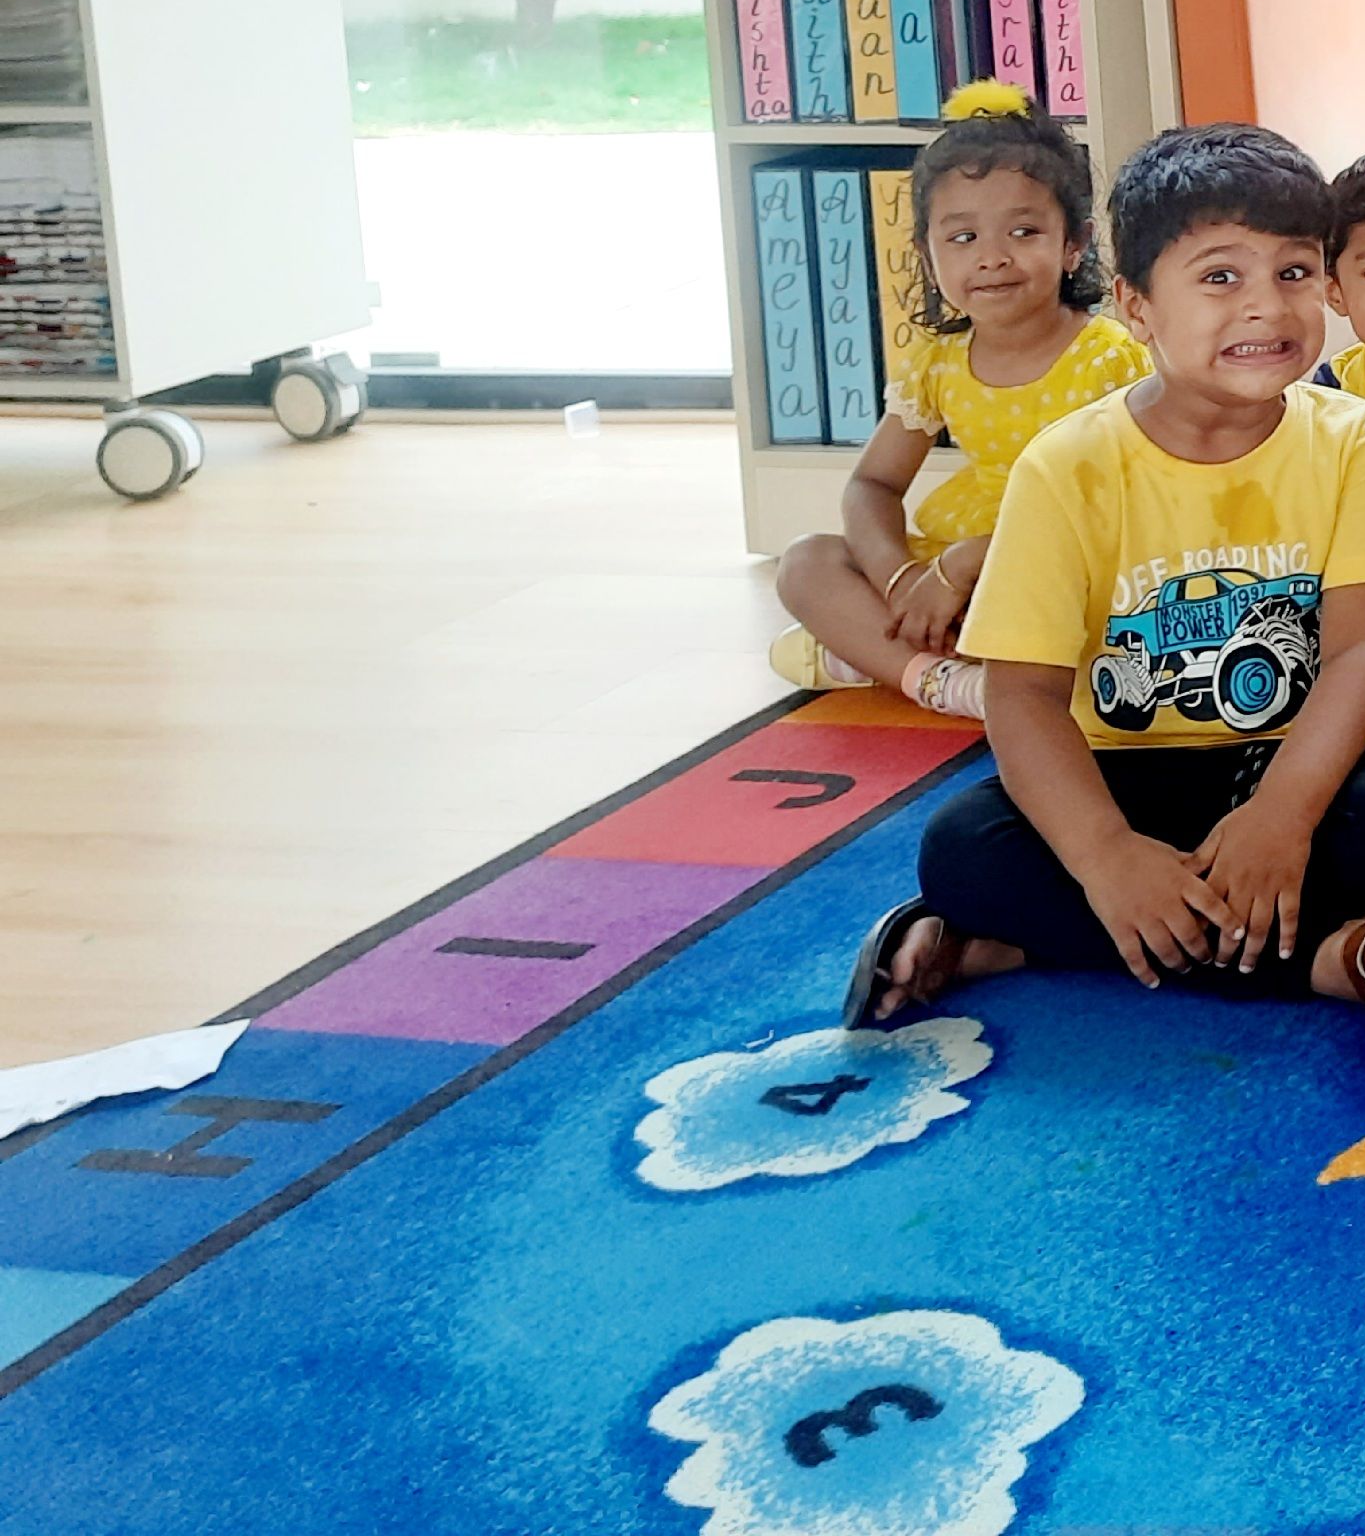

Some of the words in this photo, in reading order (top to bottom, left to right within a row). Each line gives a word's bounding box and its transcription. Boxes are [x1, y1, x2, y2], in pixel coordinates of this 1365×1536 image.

[761, 178, 816, 418] Ameya
[821, 178, 872, 419] Ayaan
[1112, 555, 1171, 612] OFF
[1182, 541, 1310, 578] ROADING
[1162, 616, 1228, 648] POWER
[72, 1095, 344, 1179] H
[759, 1073, 872, 1117] 4
[783, 1383, 947, 1468] 3
